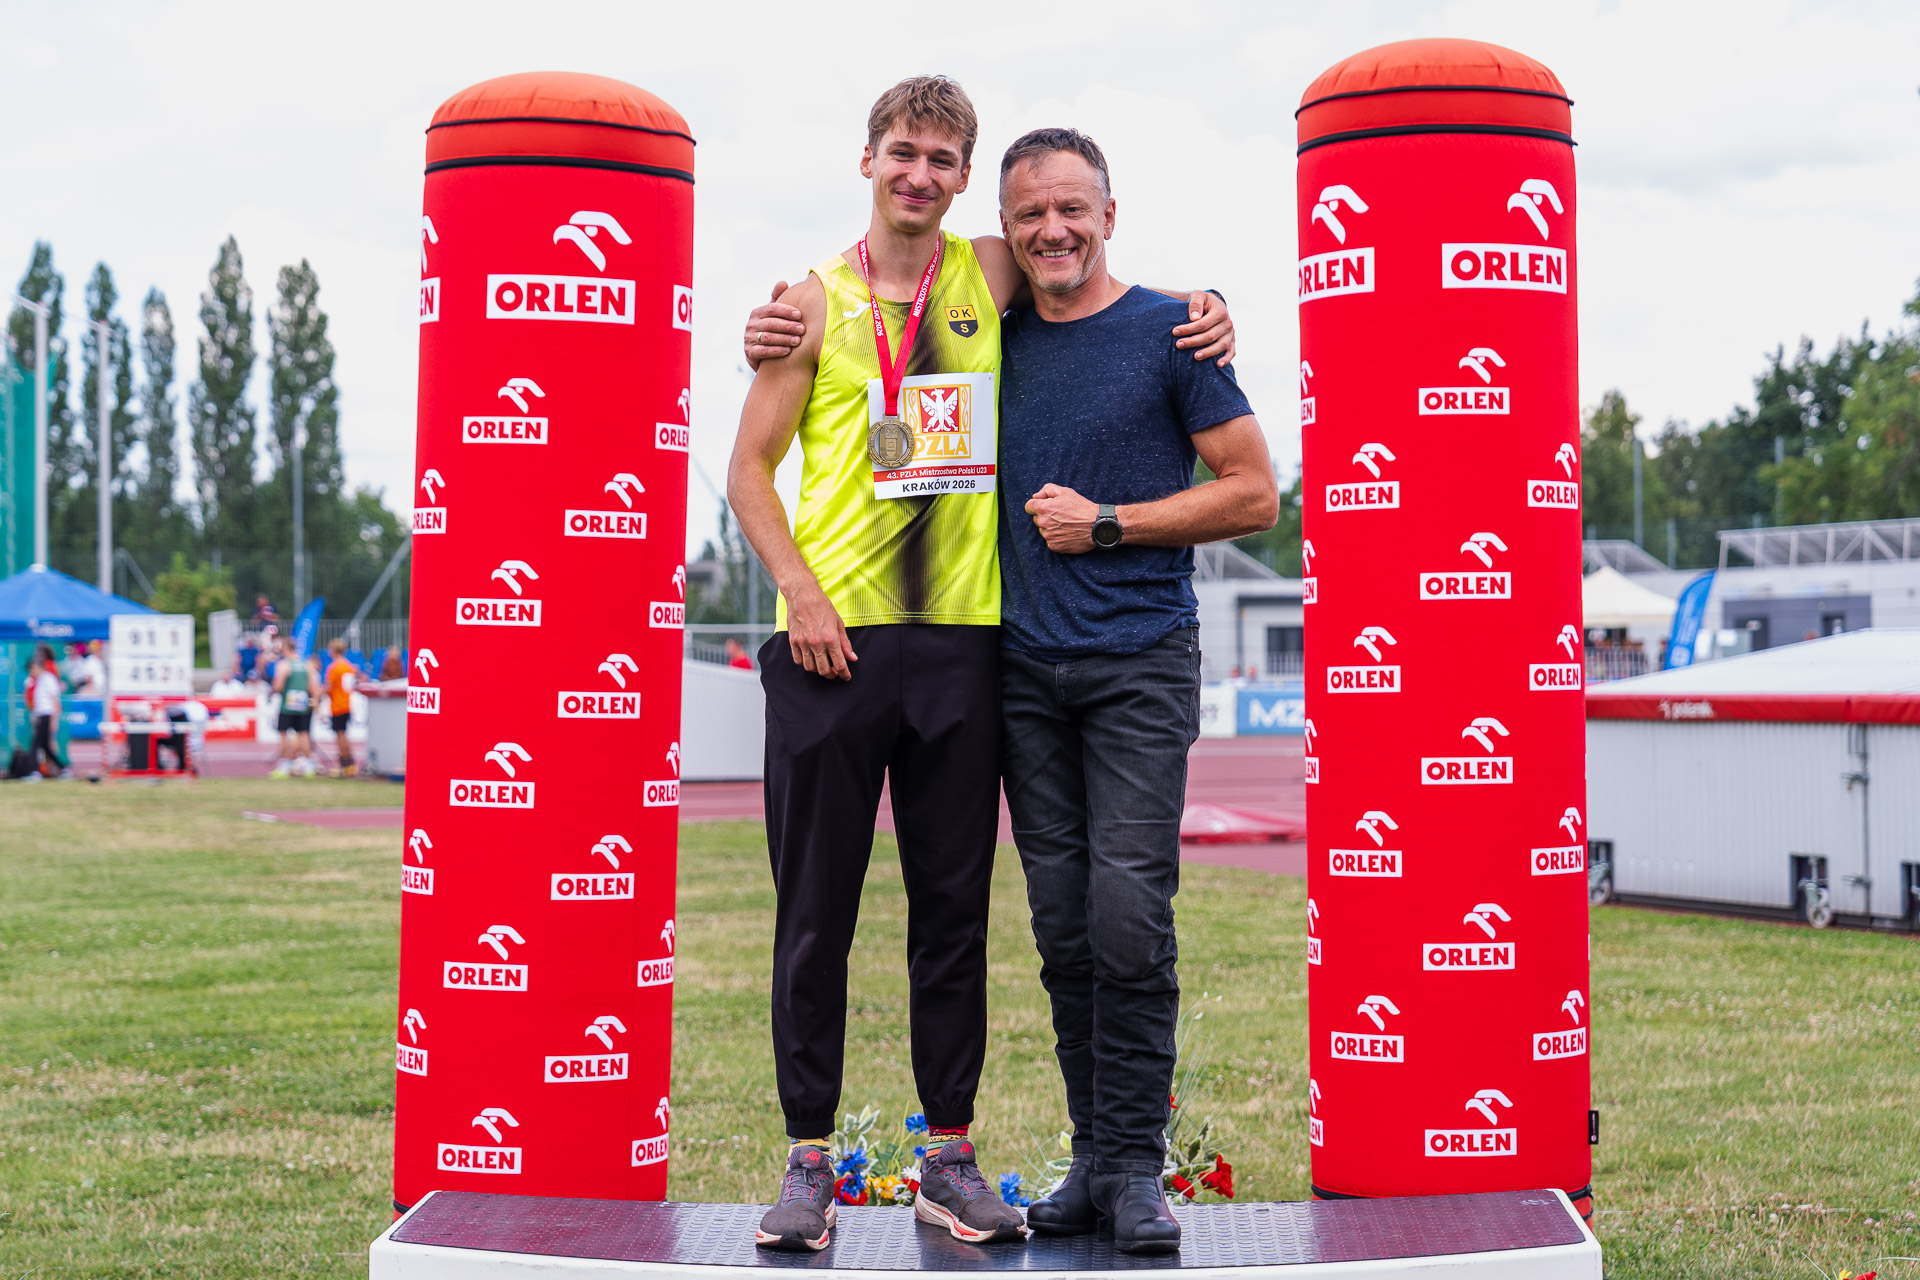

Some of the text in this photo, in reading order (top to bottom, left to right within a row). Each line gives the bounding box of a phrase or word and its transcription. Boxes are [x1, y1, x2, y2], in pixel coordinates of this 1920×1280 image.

[1298, 255, 1365, 297] RLEN
[1451, 250, 1561, 285] ORLEN
[495, 282, 625, 316] ORLEN
[875, 320, 884, 337] 2026
[960, 323, 969, 333] S
[1424, 392, 1503, 410] ORLEN
[468, 421, 541, 439] ORLEN
[913, 434, 968, 457] PZLA
[886, 466, 988, 480] 43. PZLA Mistrzostwa Polski U23
[902, 478, 976, 492] KRAKÓW 2026
[1532, 485, 1576, 504] ORLEN
[1330, 486, 1393, 507] ORLEN
[570, 515, 641, 534] ORLEN
[1426, 577, 1505, 595] ORLEN
[461, 603, 534, 621] ORLEN
[1331, 670, 1394, 689] ORLEN
[1534, 668, 1578, 686] ORLEN
[564, 696, 635, 714] ORLEN
[1427, 762, 1507, 780] ORLEN
[455, 784, 528, 803] ORLEN
[1333, 854, 1395, 872] ORLEN
[1536, 851, 1581, 871] ORLEN
[557, 878, 629, 896] ORLEN
[1429, 947, 1509, 966] ORLEN
[448, 966, 521, 986] ORLEN
[1335, 1036, 1397, 1057] ORLEN
[1538, 1032, 1583, 1055] ORLEN
[550, 1058, 623, 1078] ORLEN
[1430, 1133, 1511, 1152] ORLEN
[442, 1148, 515, 1169] ORLEN
